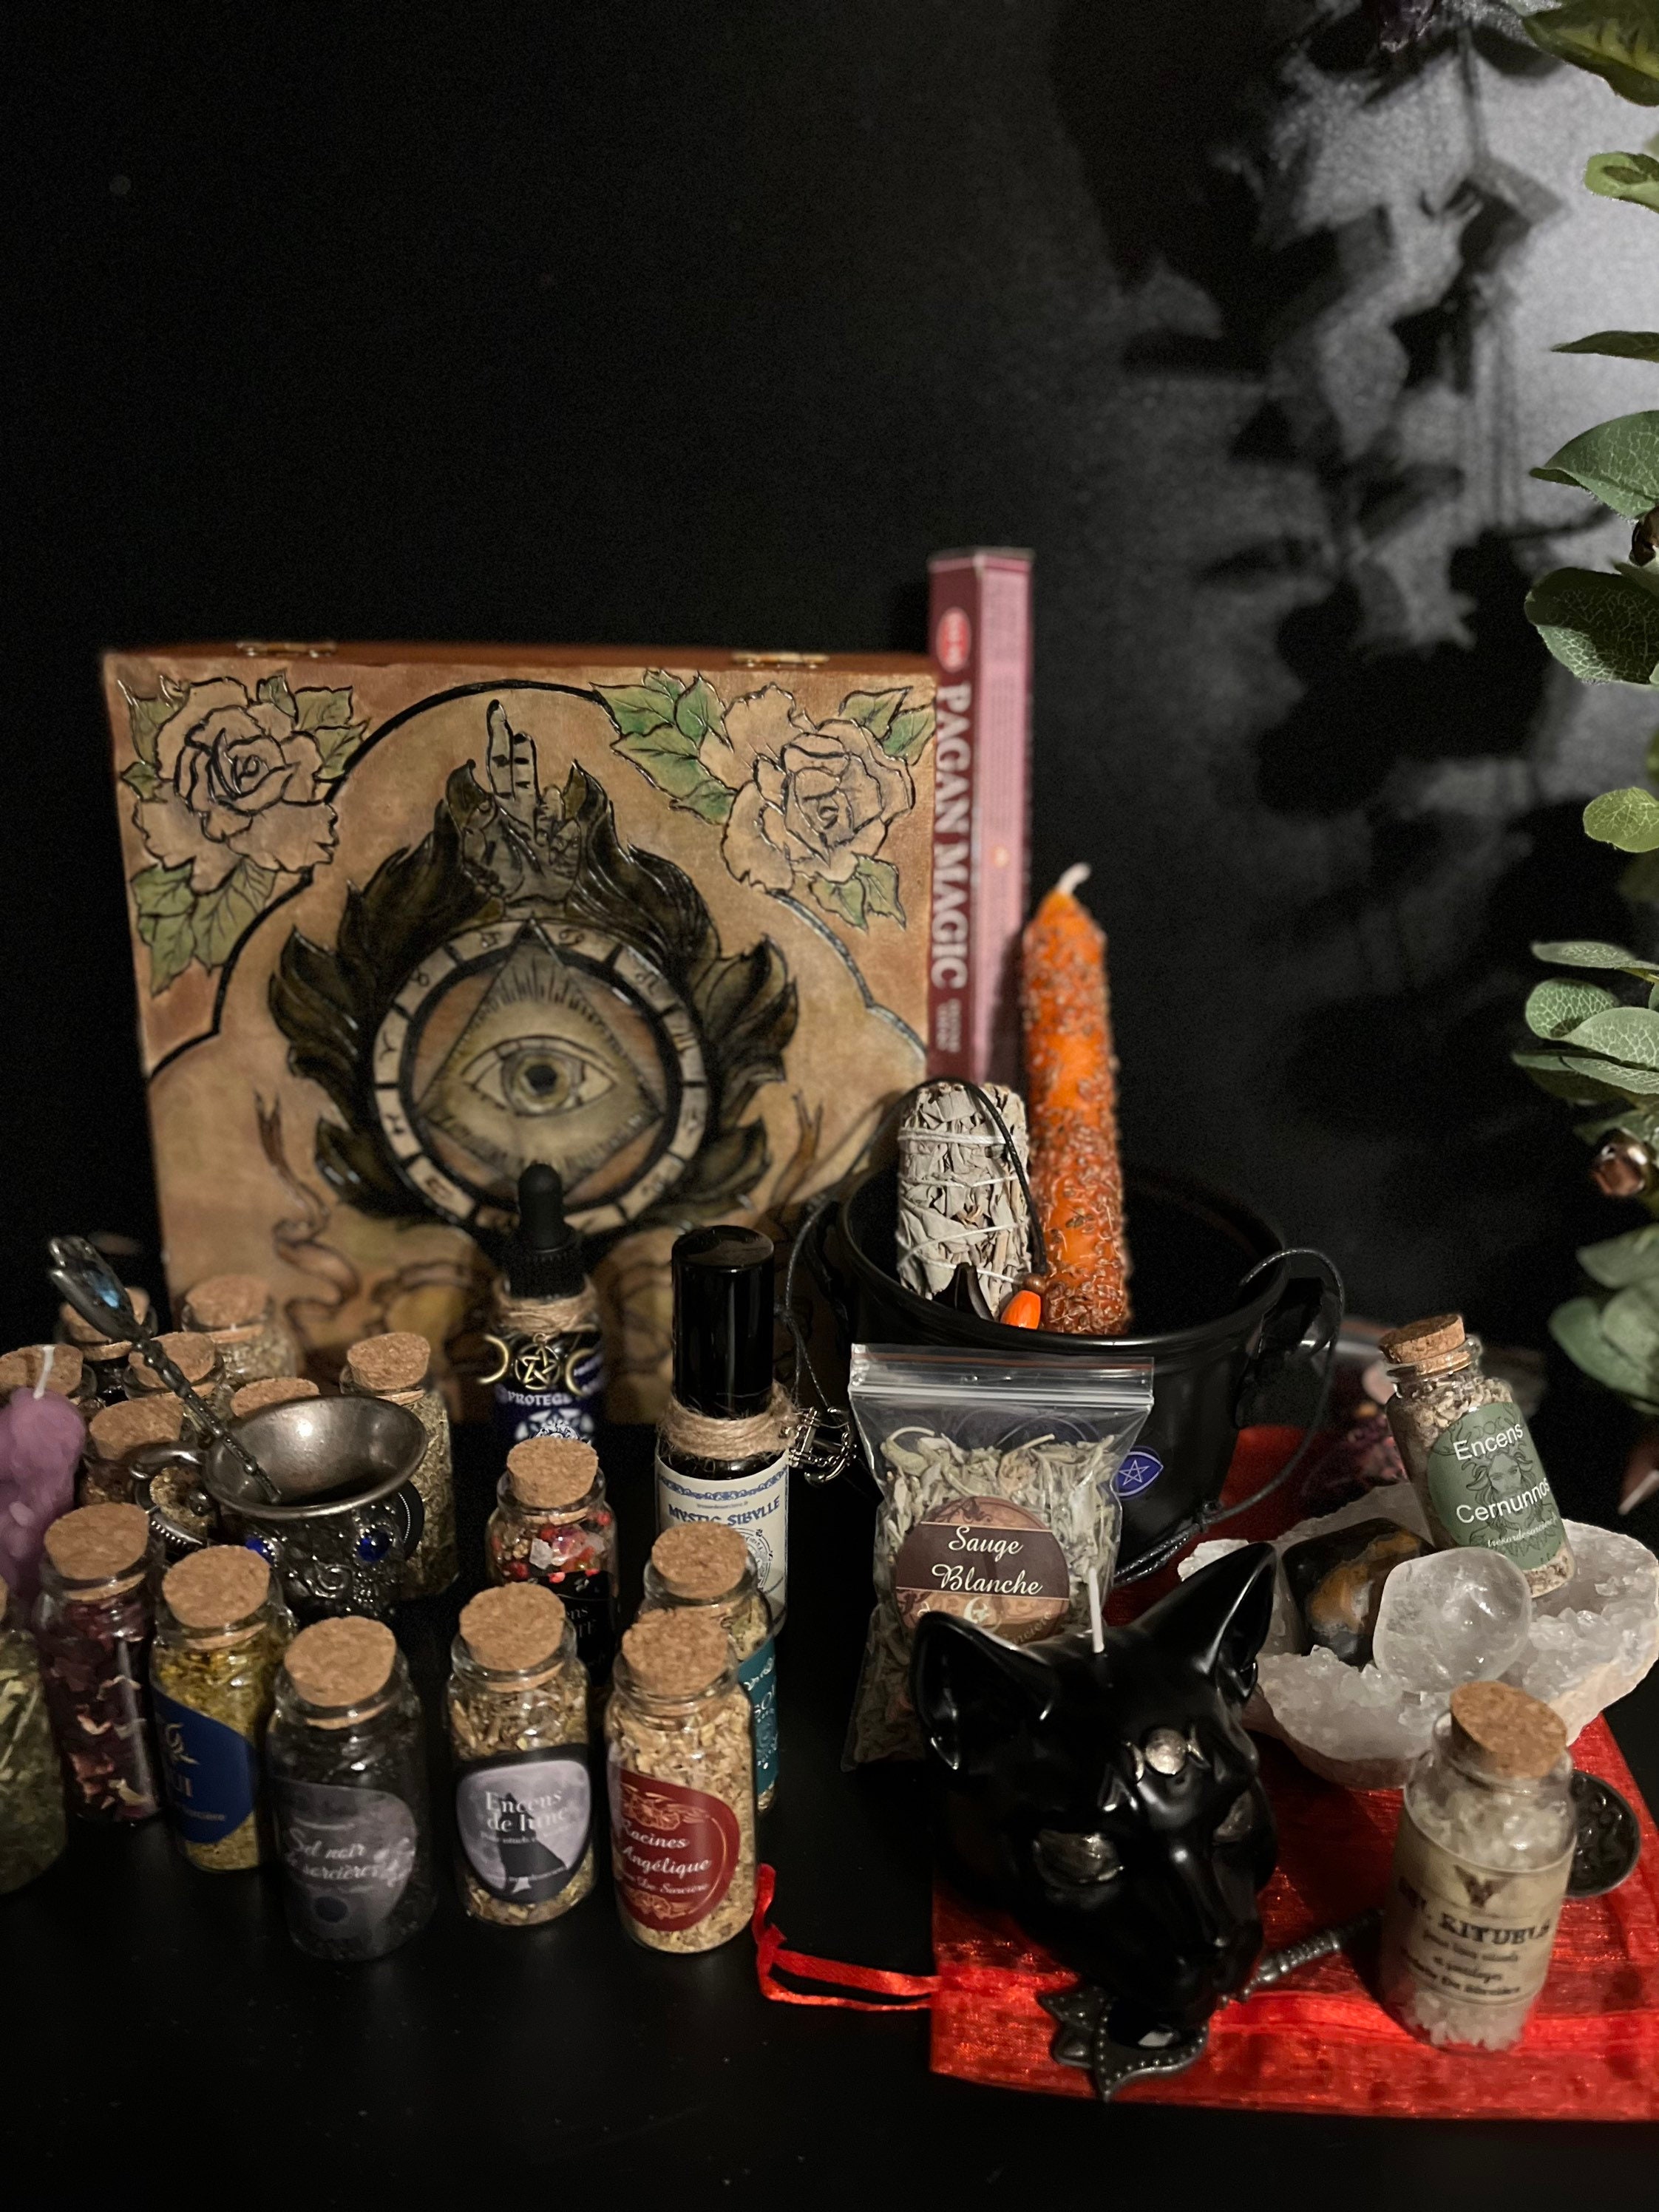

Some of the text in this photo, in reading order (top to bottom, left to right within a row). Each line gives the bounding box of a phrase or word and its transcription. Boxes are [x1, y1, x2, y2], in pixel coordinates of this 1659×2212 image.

[935, 682, 971, 833] PAGAN
[931, 841, 970, 990] MAGIC
[1453, 1422, 1524, 1461] Encens
[1456, 1477, 1551, 1524] Cernunnos
[949, 1525, 1024, 1561] Sauge
[932, 1564, 1043, 1595] Blanche
[485, 1789, 563, 1814] Encens
[486, 1812, 514, 1833] de
